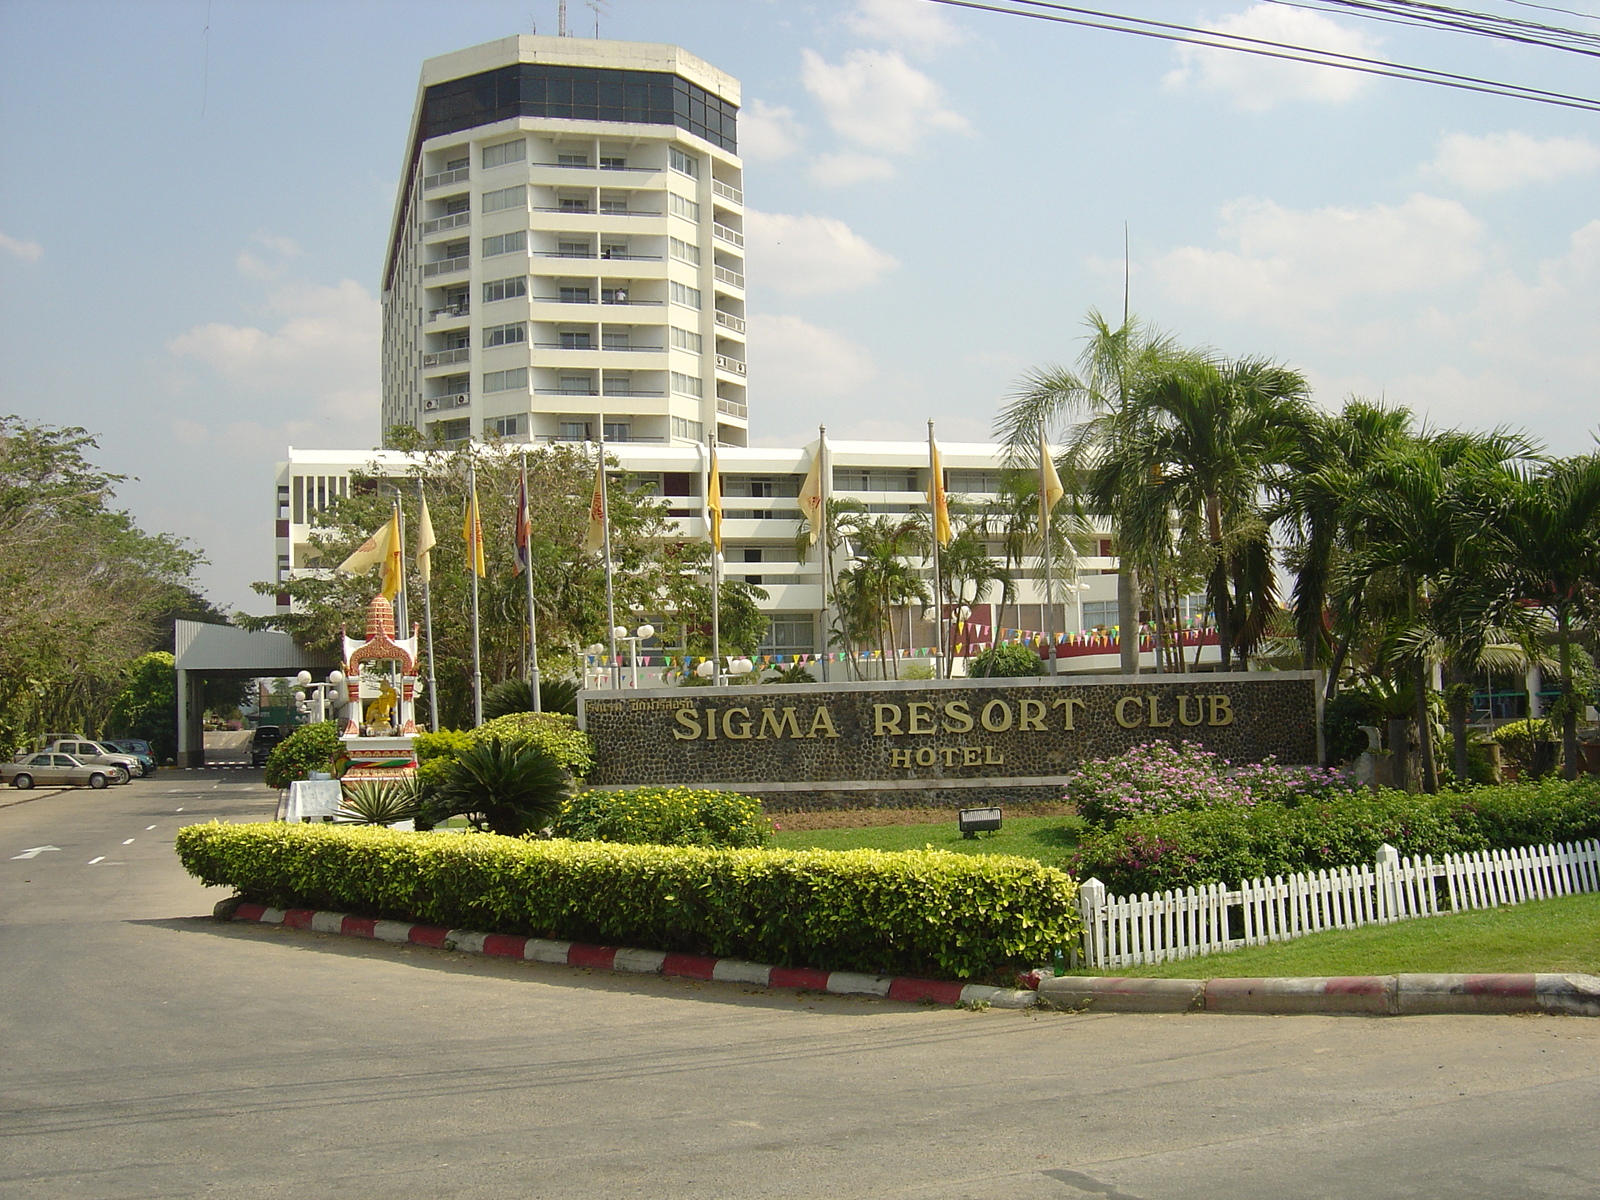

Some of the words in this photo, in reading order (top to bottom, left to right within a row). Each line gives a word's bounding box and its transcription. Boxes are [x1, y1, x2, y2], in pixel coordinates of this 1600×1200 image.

[672, 706, 841, 740] SIGMA
[873, 698, 1085, 736] RESORT
[1115, 694, 1234, 729] CLUB
[890, 745, 1004, 768] HOTEL
